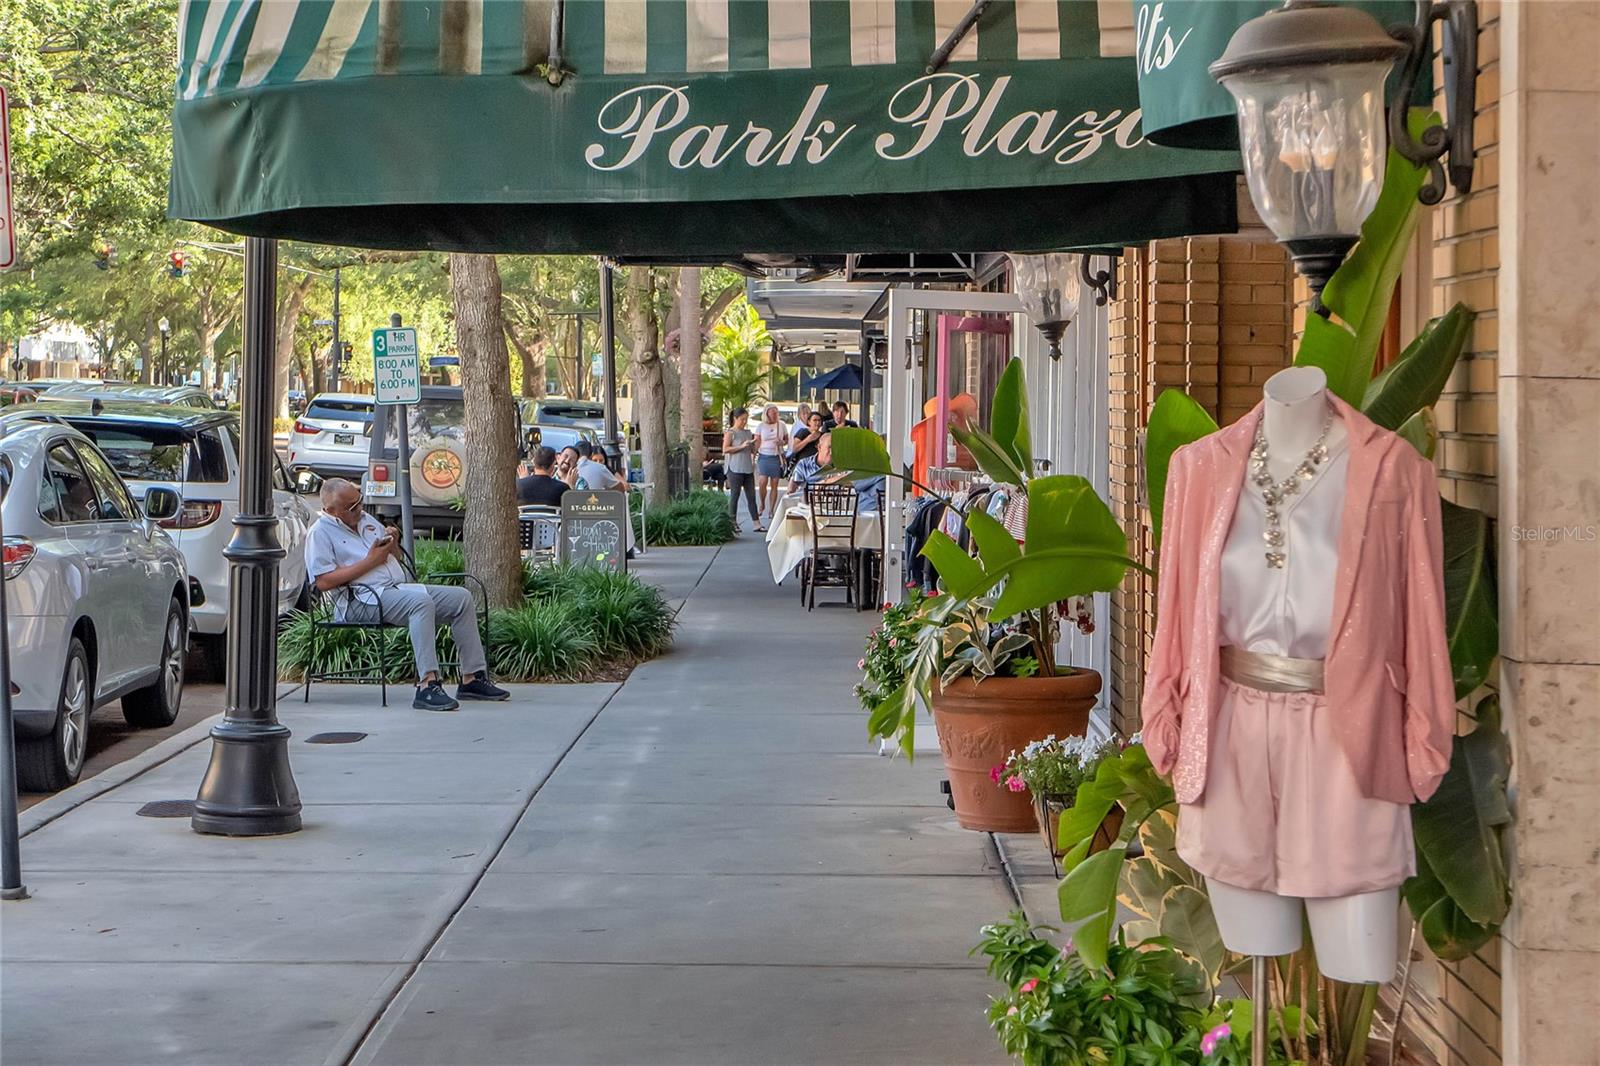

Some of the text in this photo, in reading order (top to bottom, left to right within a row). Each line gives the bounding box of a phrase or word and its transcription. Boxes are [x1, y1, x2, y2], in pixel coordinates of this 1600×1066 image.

[584, 84, 857, 172] Park
[376, 332, 406, 351] 3 HR
[389, 345, 414, 353] PARKING
[378, 359, 415, 369] 8:00 AM
[391, 370, 402, 379] TO
[381, 379, 415, 389] 6:00 PM
[570, 520, 602, 541] Happy
